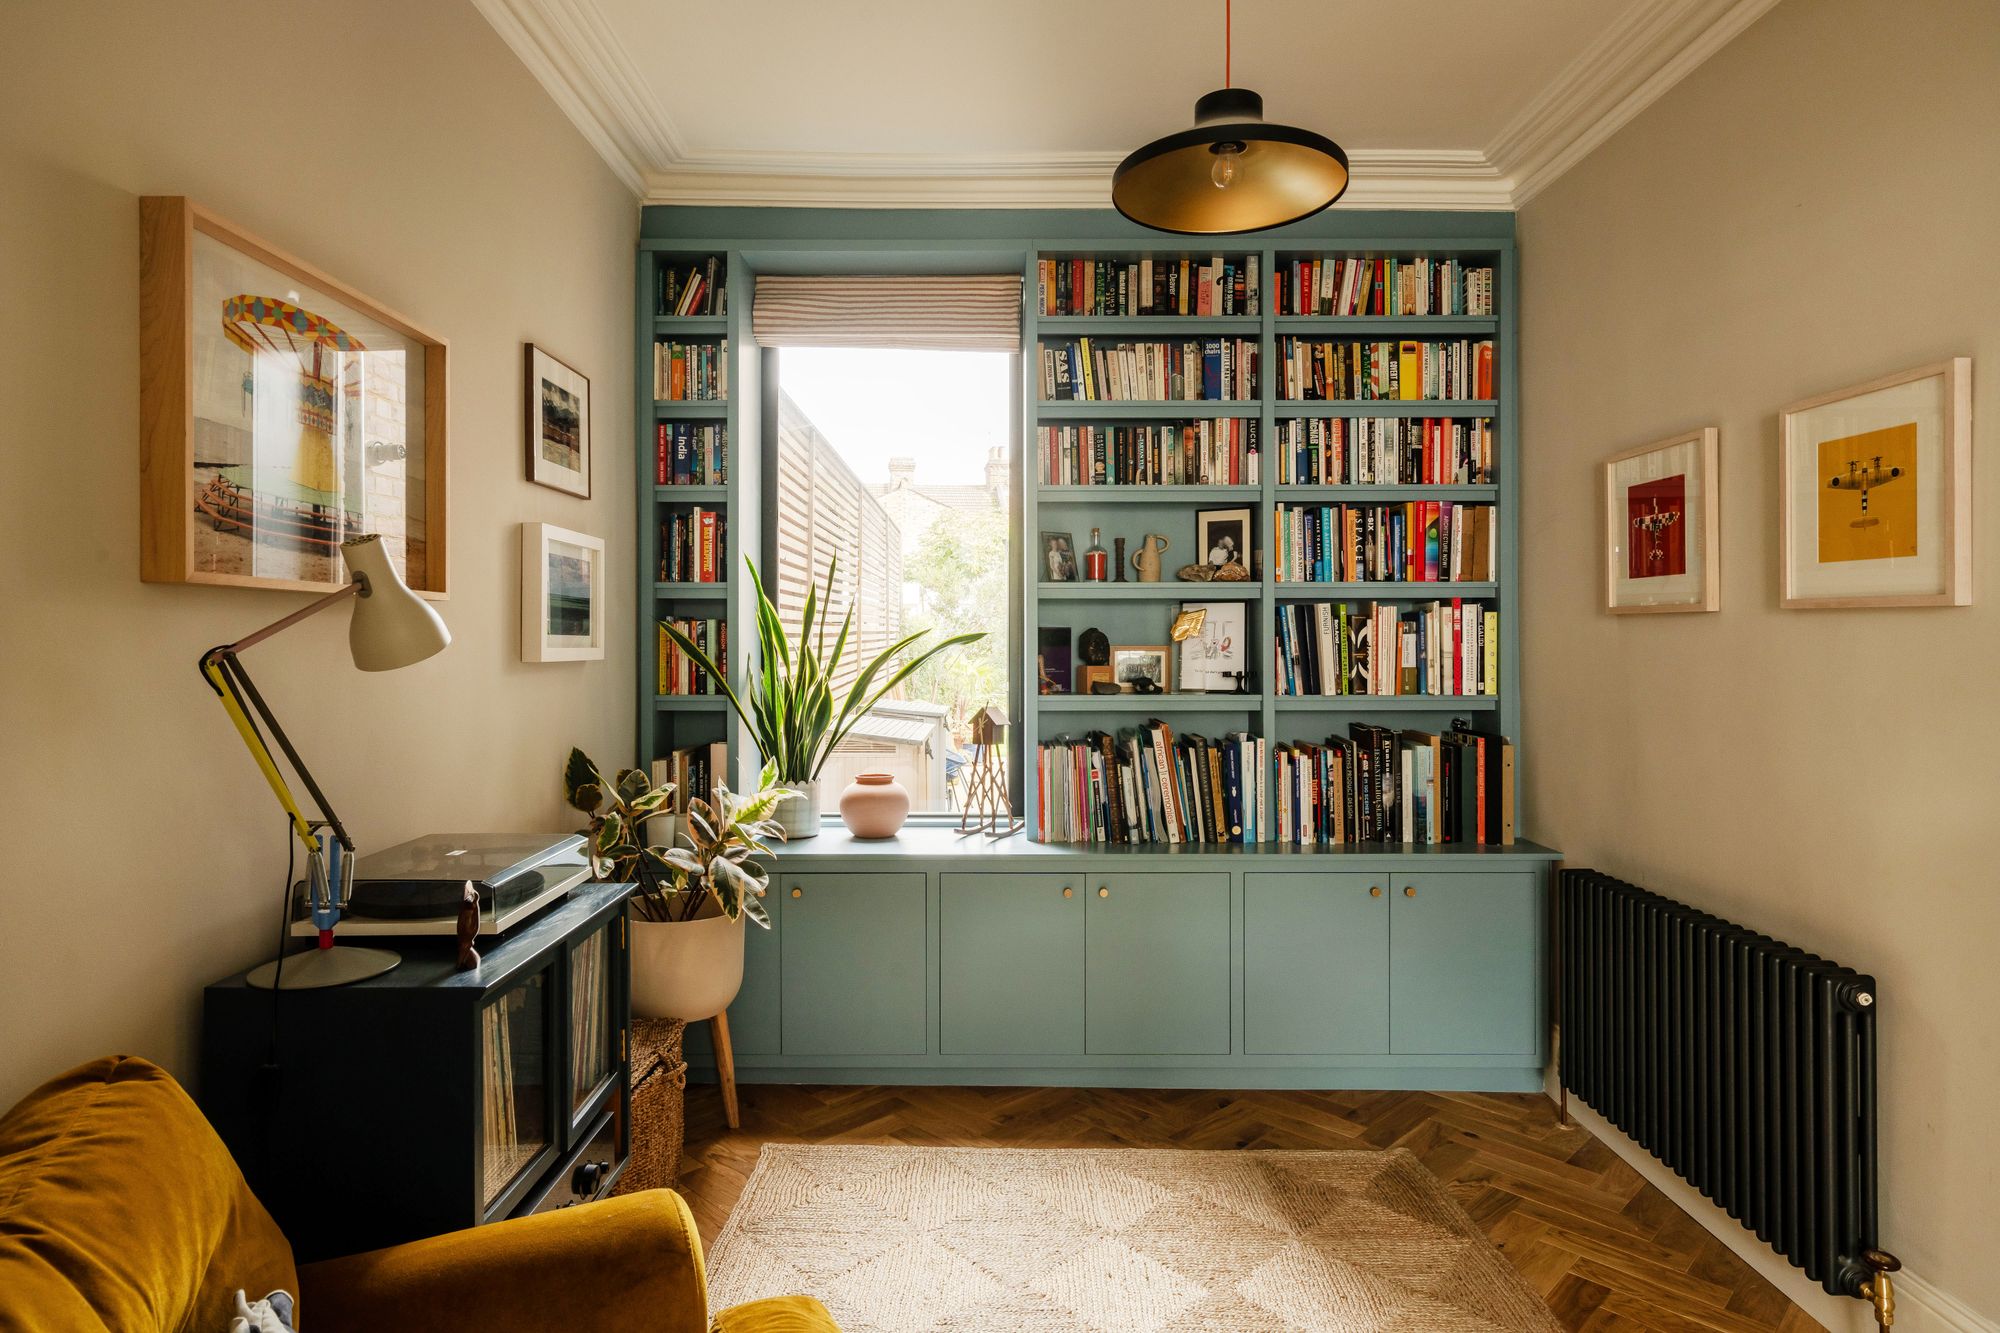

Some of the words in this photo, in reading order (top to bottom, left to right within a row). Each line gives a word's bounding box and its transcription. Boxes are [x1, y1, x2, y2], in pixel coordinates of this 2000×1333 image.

[1060, 351, 1070, 383] SAS
[1390, 361, 1398, 379] COVERT
[1390, 380, 1398, 390] OPS
[1310, 419, 1318, 444] McNAB
[678, 436, 687, 460] India
[1155, 741, 1165, 769] african
[1161, 777, 1174, 824] ceremonies
